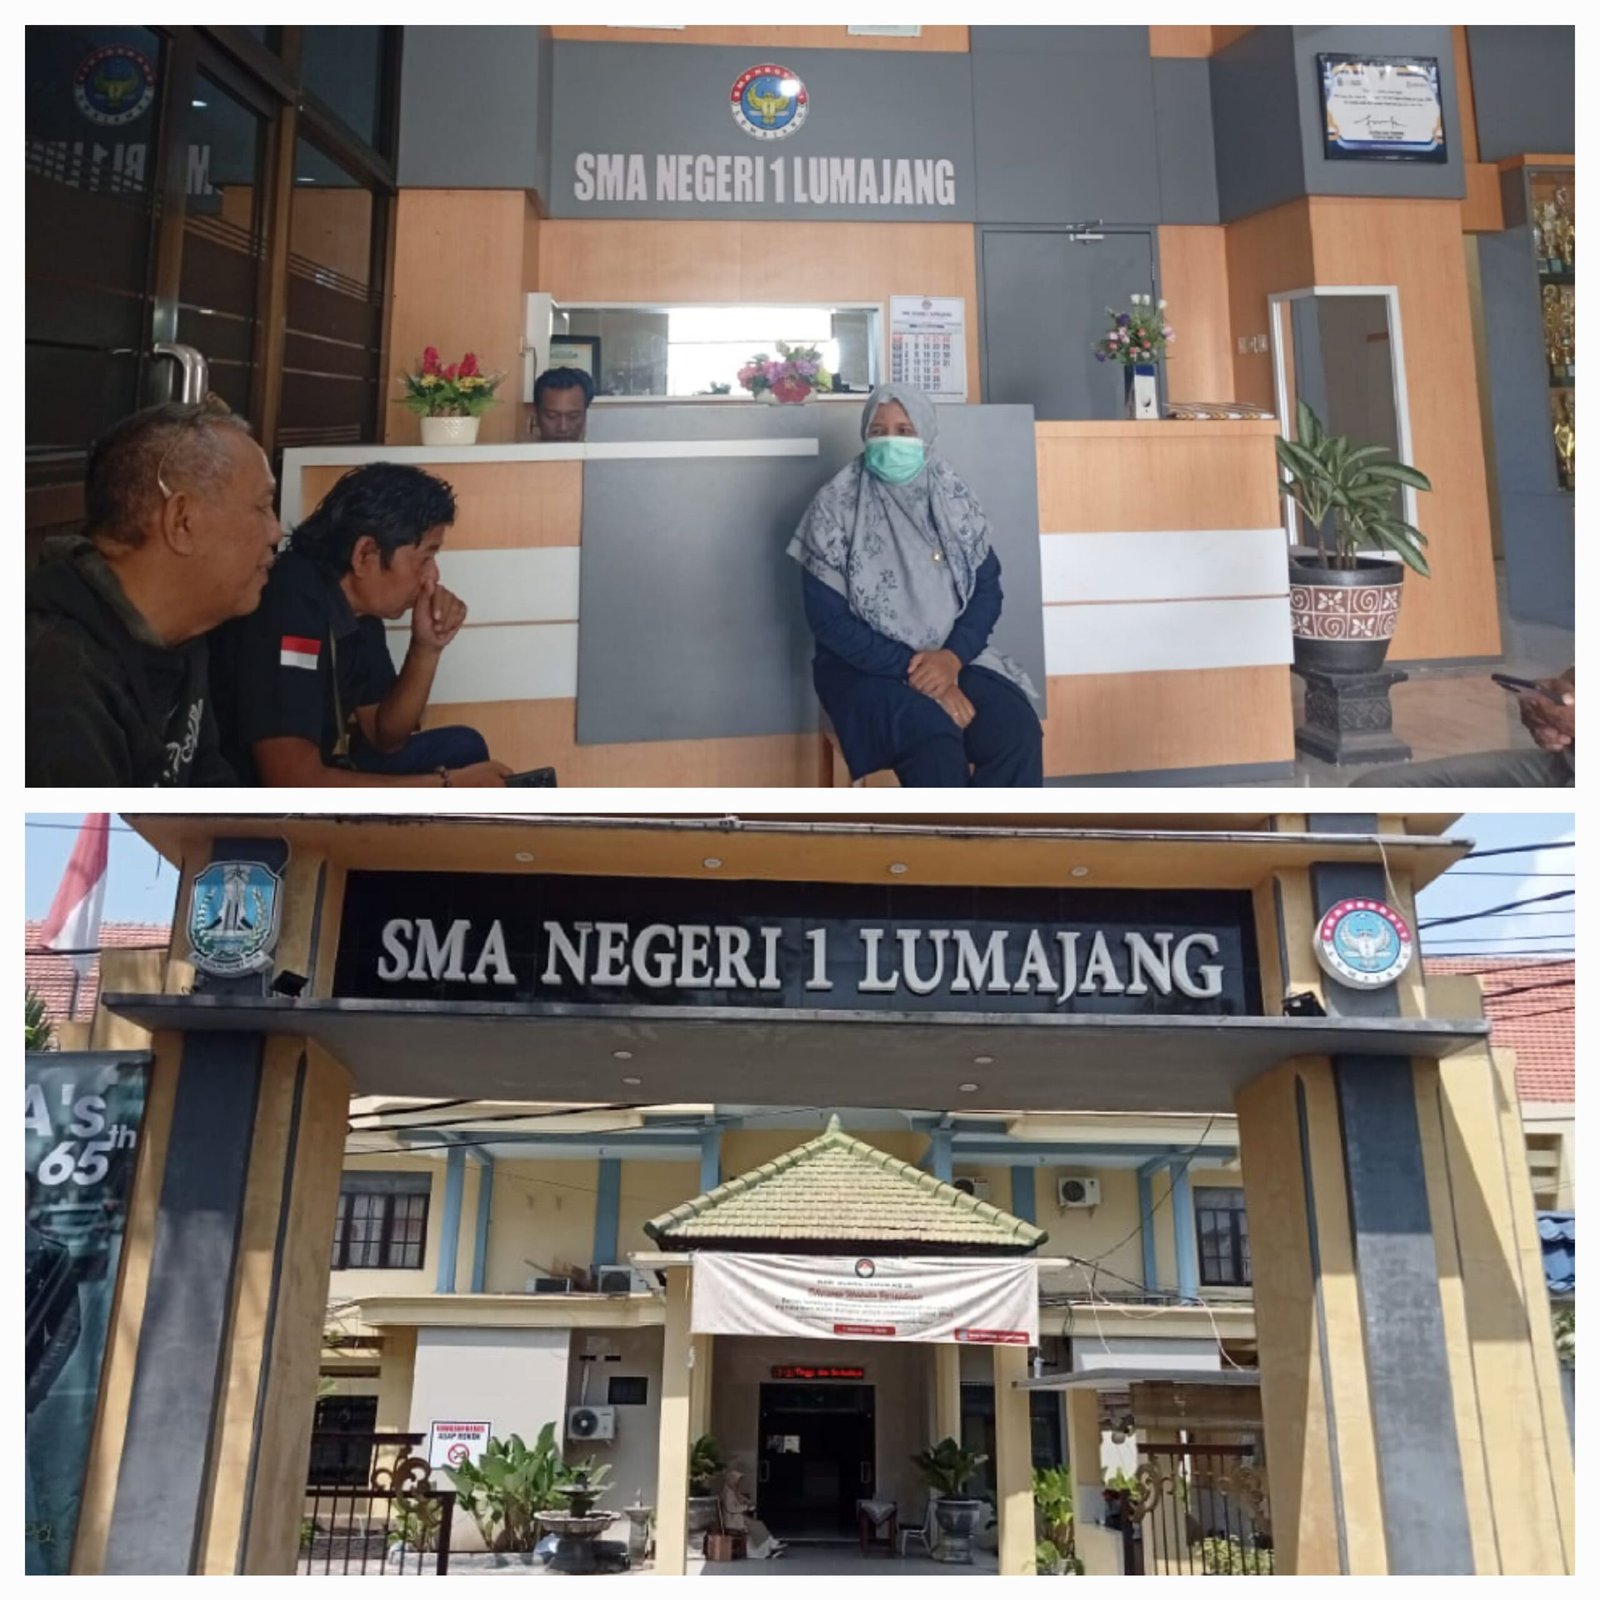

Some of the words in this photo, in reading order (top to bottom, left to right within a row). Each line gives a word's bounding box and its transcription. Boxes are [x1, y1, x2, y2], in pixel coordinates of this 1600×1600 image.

[574, 152, 647, 201] SMA
[655, 154, 765, 203] NEGERI
[769, 156, 785, 203] 1
[793, 156, 956, 206] LUMAJANG
[377, 918, 517, 984] SMA
[541, 921, 782, 989] NEGERI
[805, 928, 833, 989] 1
[858, 928, 1224, 1005] LUMAJANG
